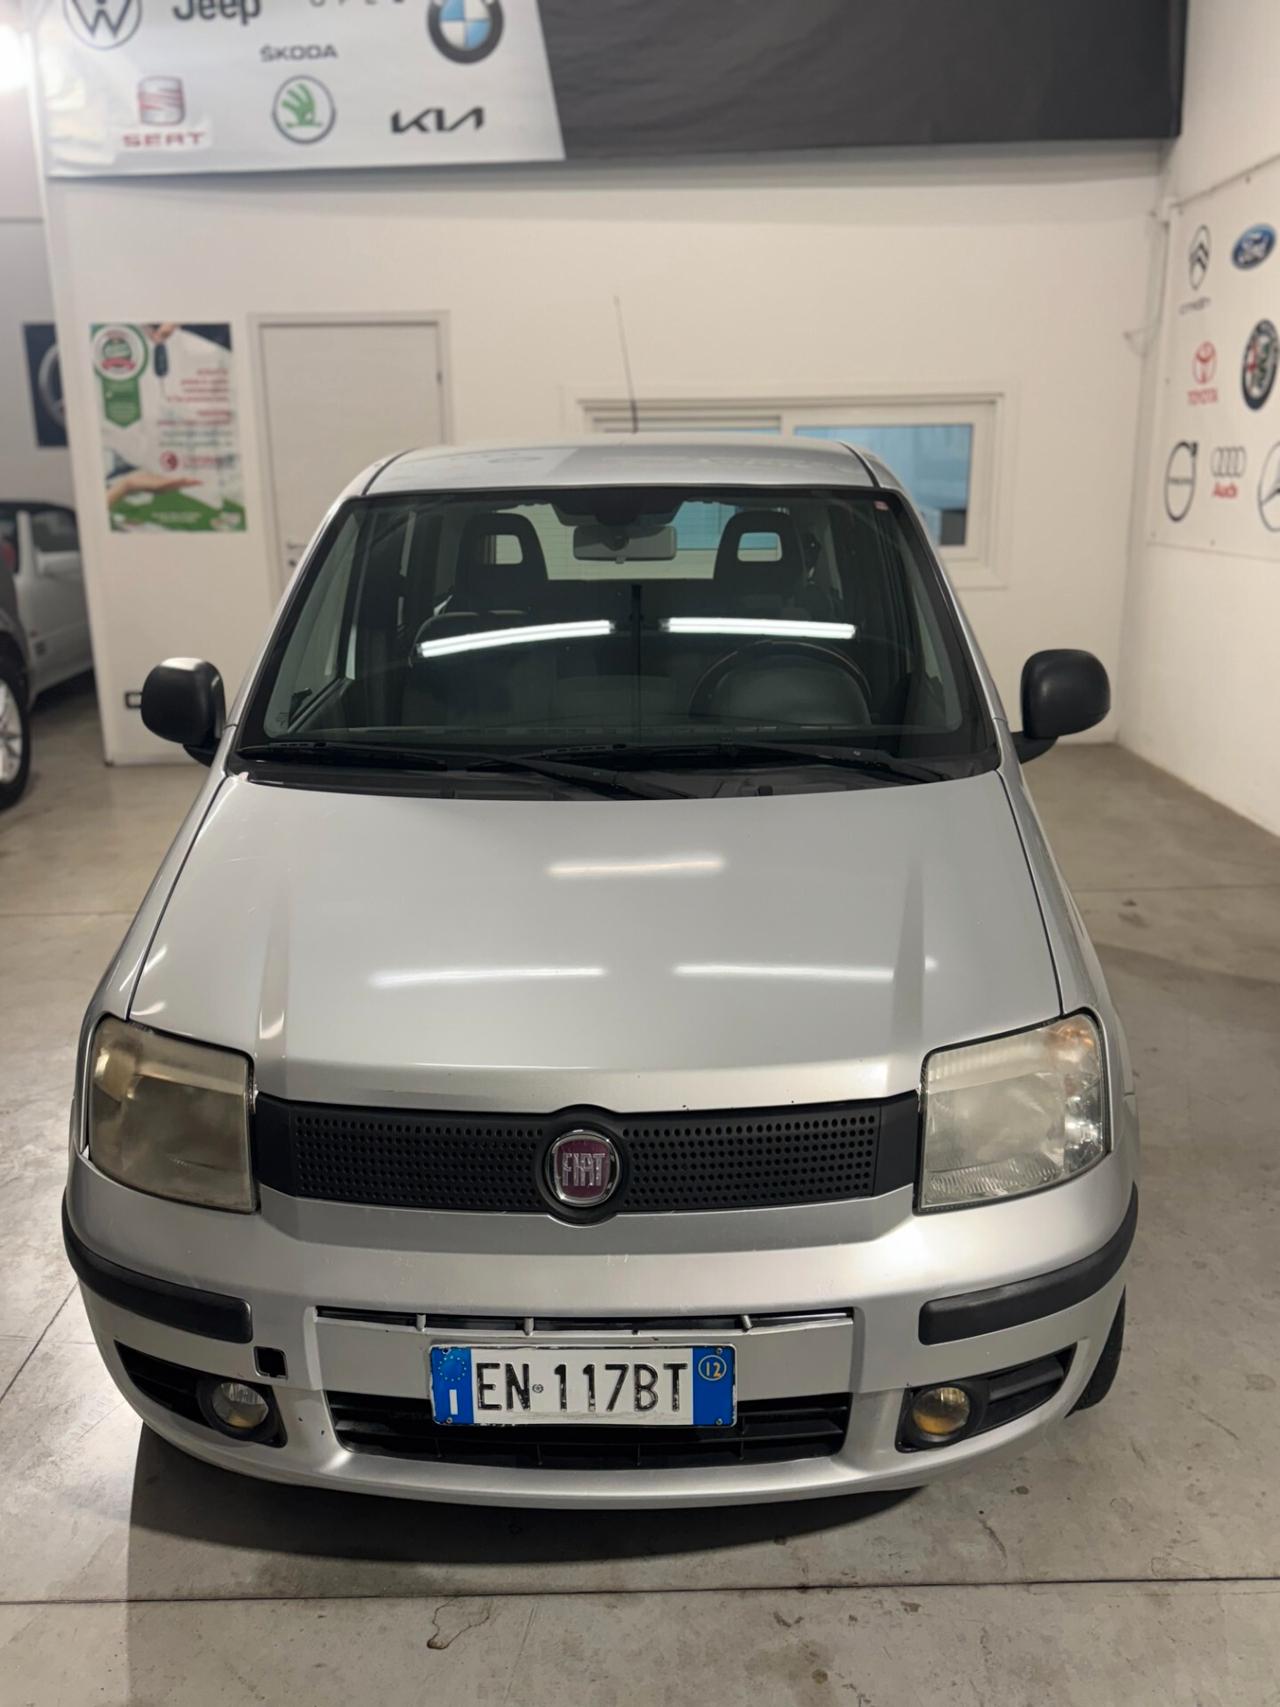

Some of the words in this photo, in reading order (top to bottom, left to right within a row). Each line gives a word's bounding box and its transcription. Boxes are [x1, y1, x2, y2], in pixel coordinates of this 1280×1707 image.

[173, 0, 261, 25] Jeep
[562, 1153, 606, 1186] FIAT
[449, 1389, 458, 1415] I
[475, 1362, 532, 1411] EN
[554, 1362, 689, 1412] 117BT
[703, 1361, 722, 1377] 12
